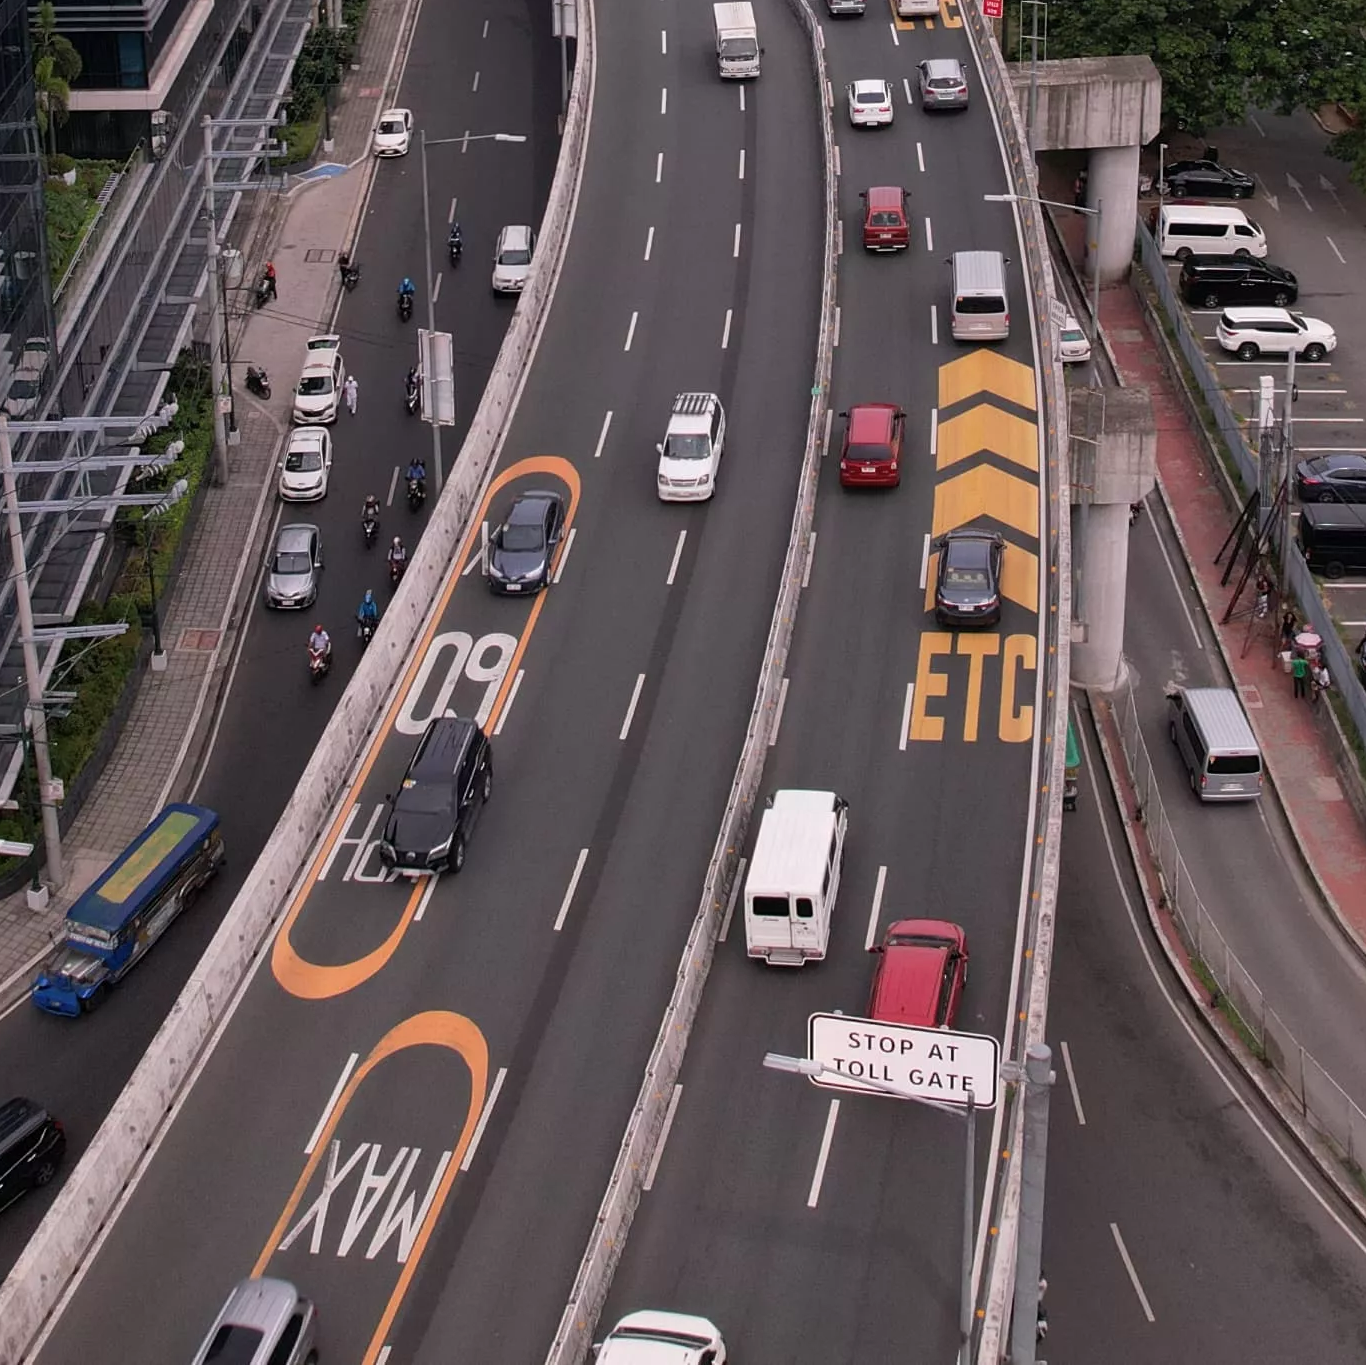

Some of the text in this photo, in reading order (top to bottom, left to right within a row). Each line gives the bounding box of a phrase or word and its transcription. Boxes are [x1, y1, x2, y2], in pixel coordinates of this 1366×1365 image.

[909, 632, 1037, 743] ETC
[317, 803, 419, 883] PH
[833, 1057, 974, 1092] TOLL GATE
[847, 1032, 959, 1062] STOP AT
[277, 1139, 453, 1263] MAX
